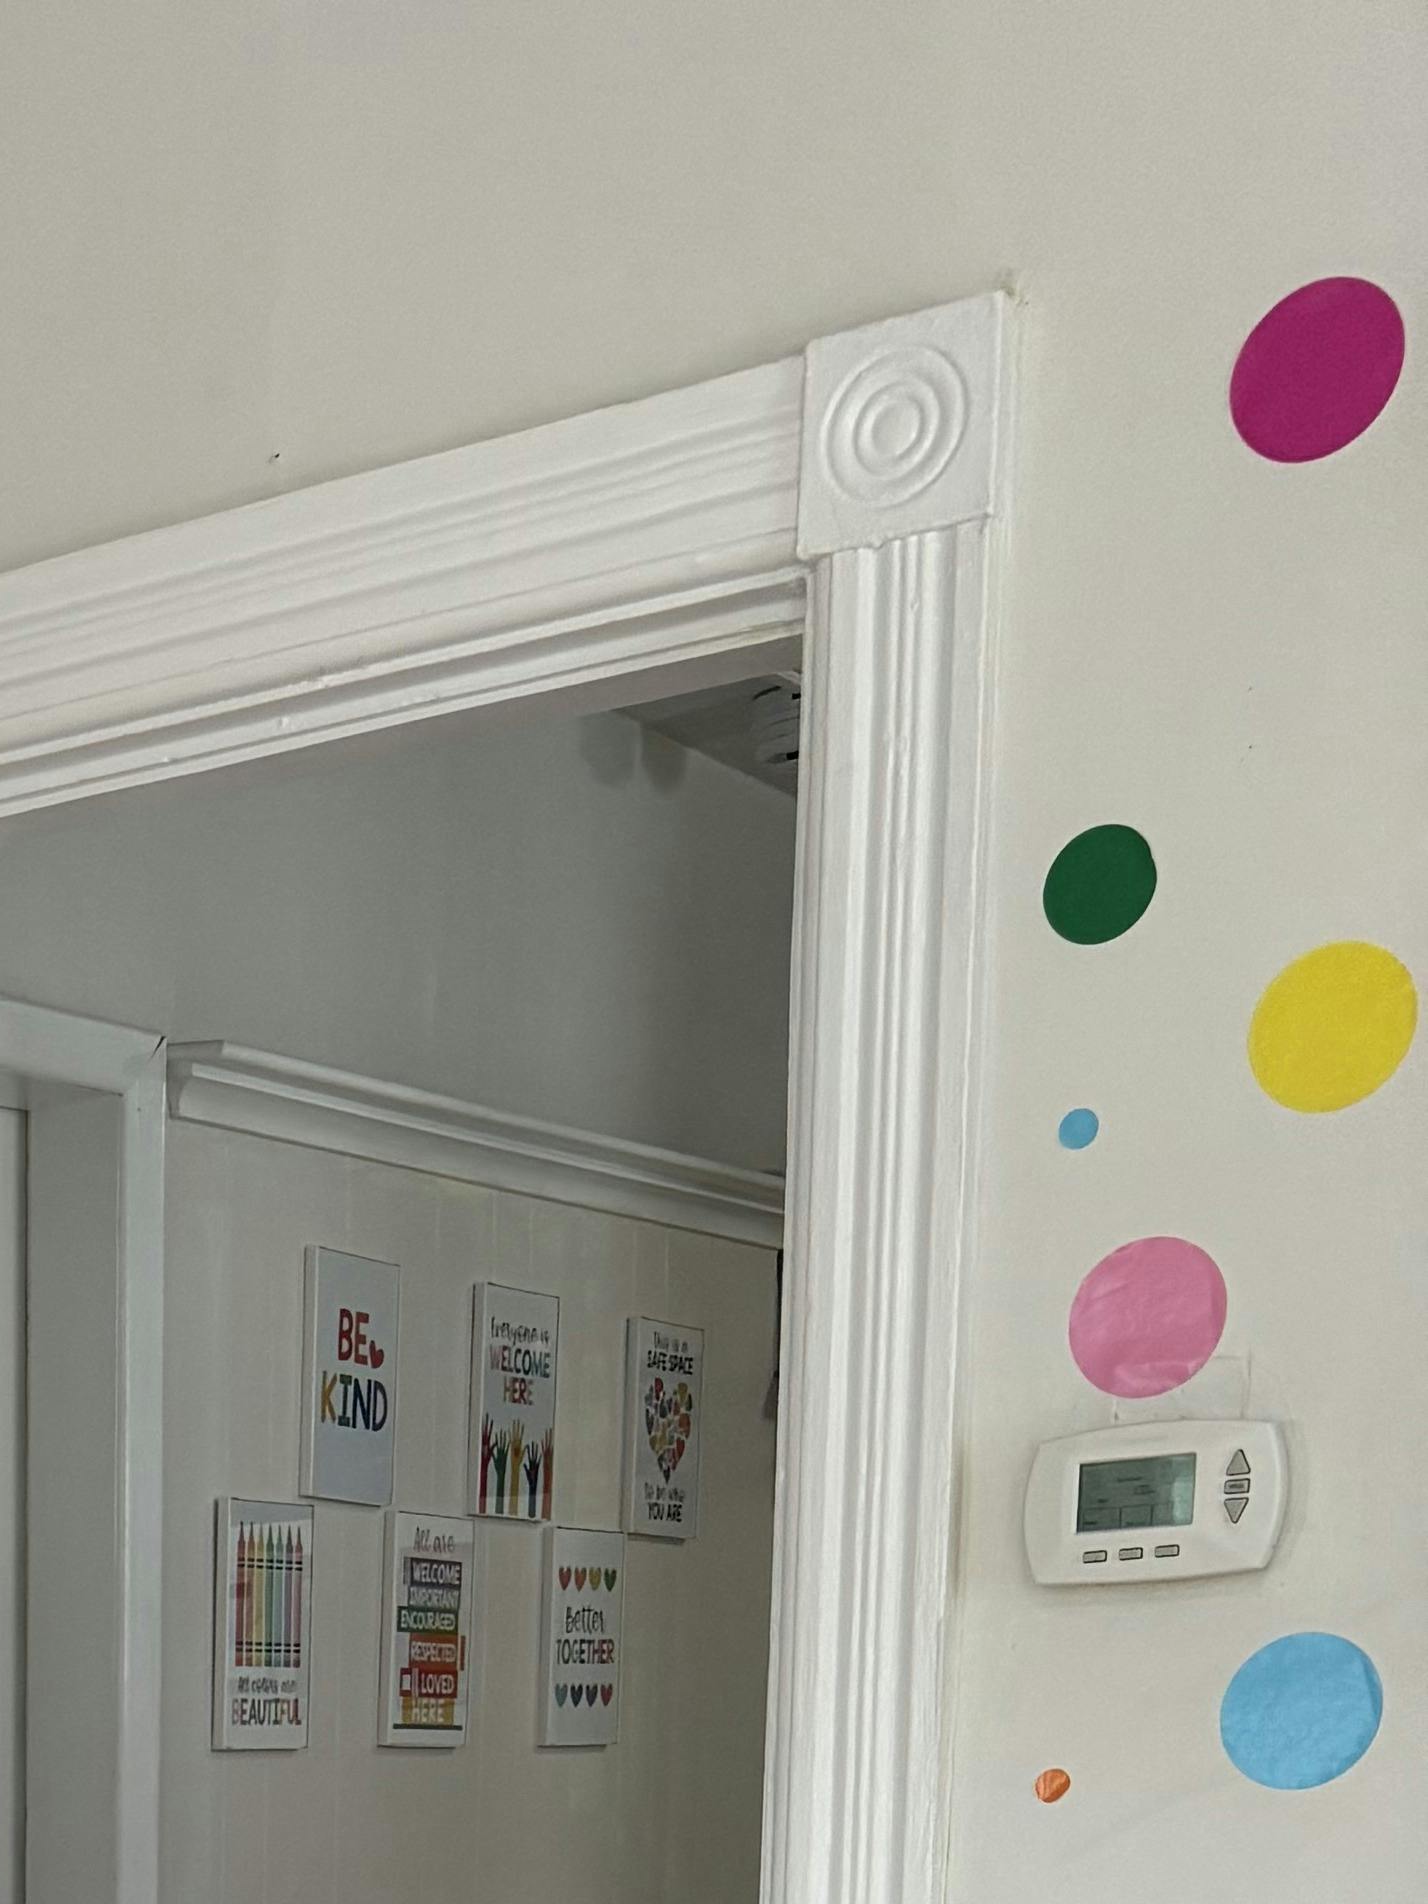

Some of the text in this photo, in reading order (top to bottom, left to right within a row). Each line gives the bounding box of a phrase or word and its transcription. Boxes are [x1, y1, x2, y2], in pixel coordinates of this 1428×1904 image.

[338, 1308, 369, 1365] BE
[490, 1345, 550, 1378] WELCOME
[647, 1351, 693, 1375] SAFE SPACE
[321, 1371, 387, 1432] KIND
[504, 1378, 534, 1405] HERE
[412, 1564, 460, 1584] WELCOME
[565, 1606, 605, 1634] Better
[556, 1639, 615, 1665] TOGETHER
[421, 1673, 454, 1694] LOVED
[232, 1698, 302, 1725] BEAUTIFUL
